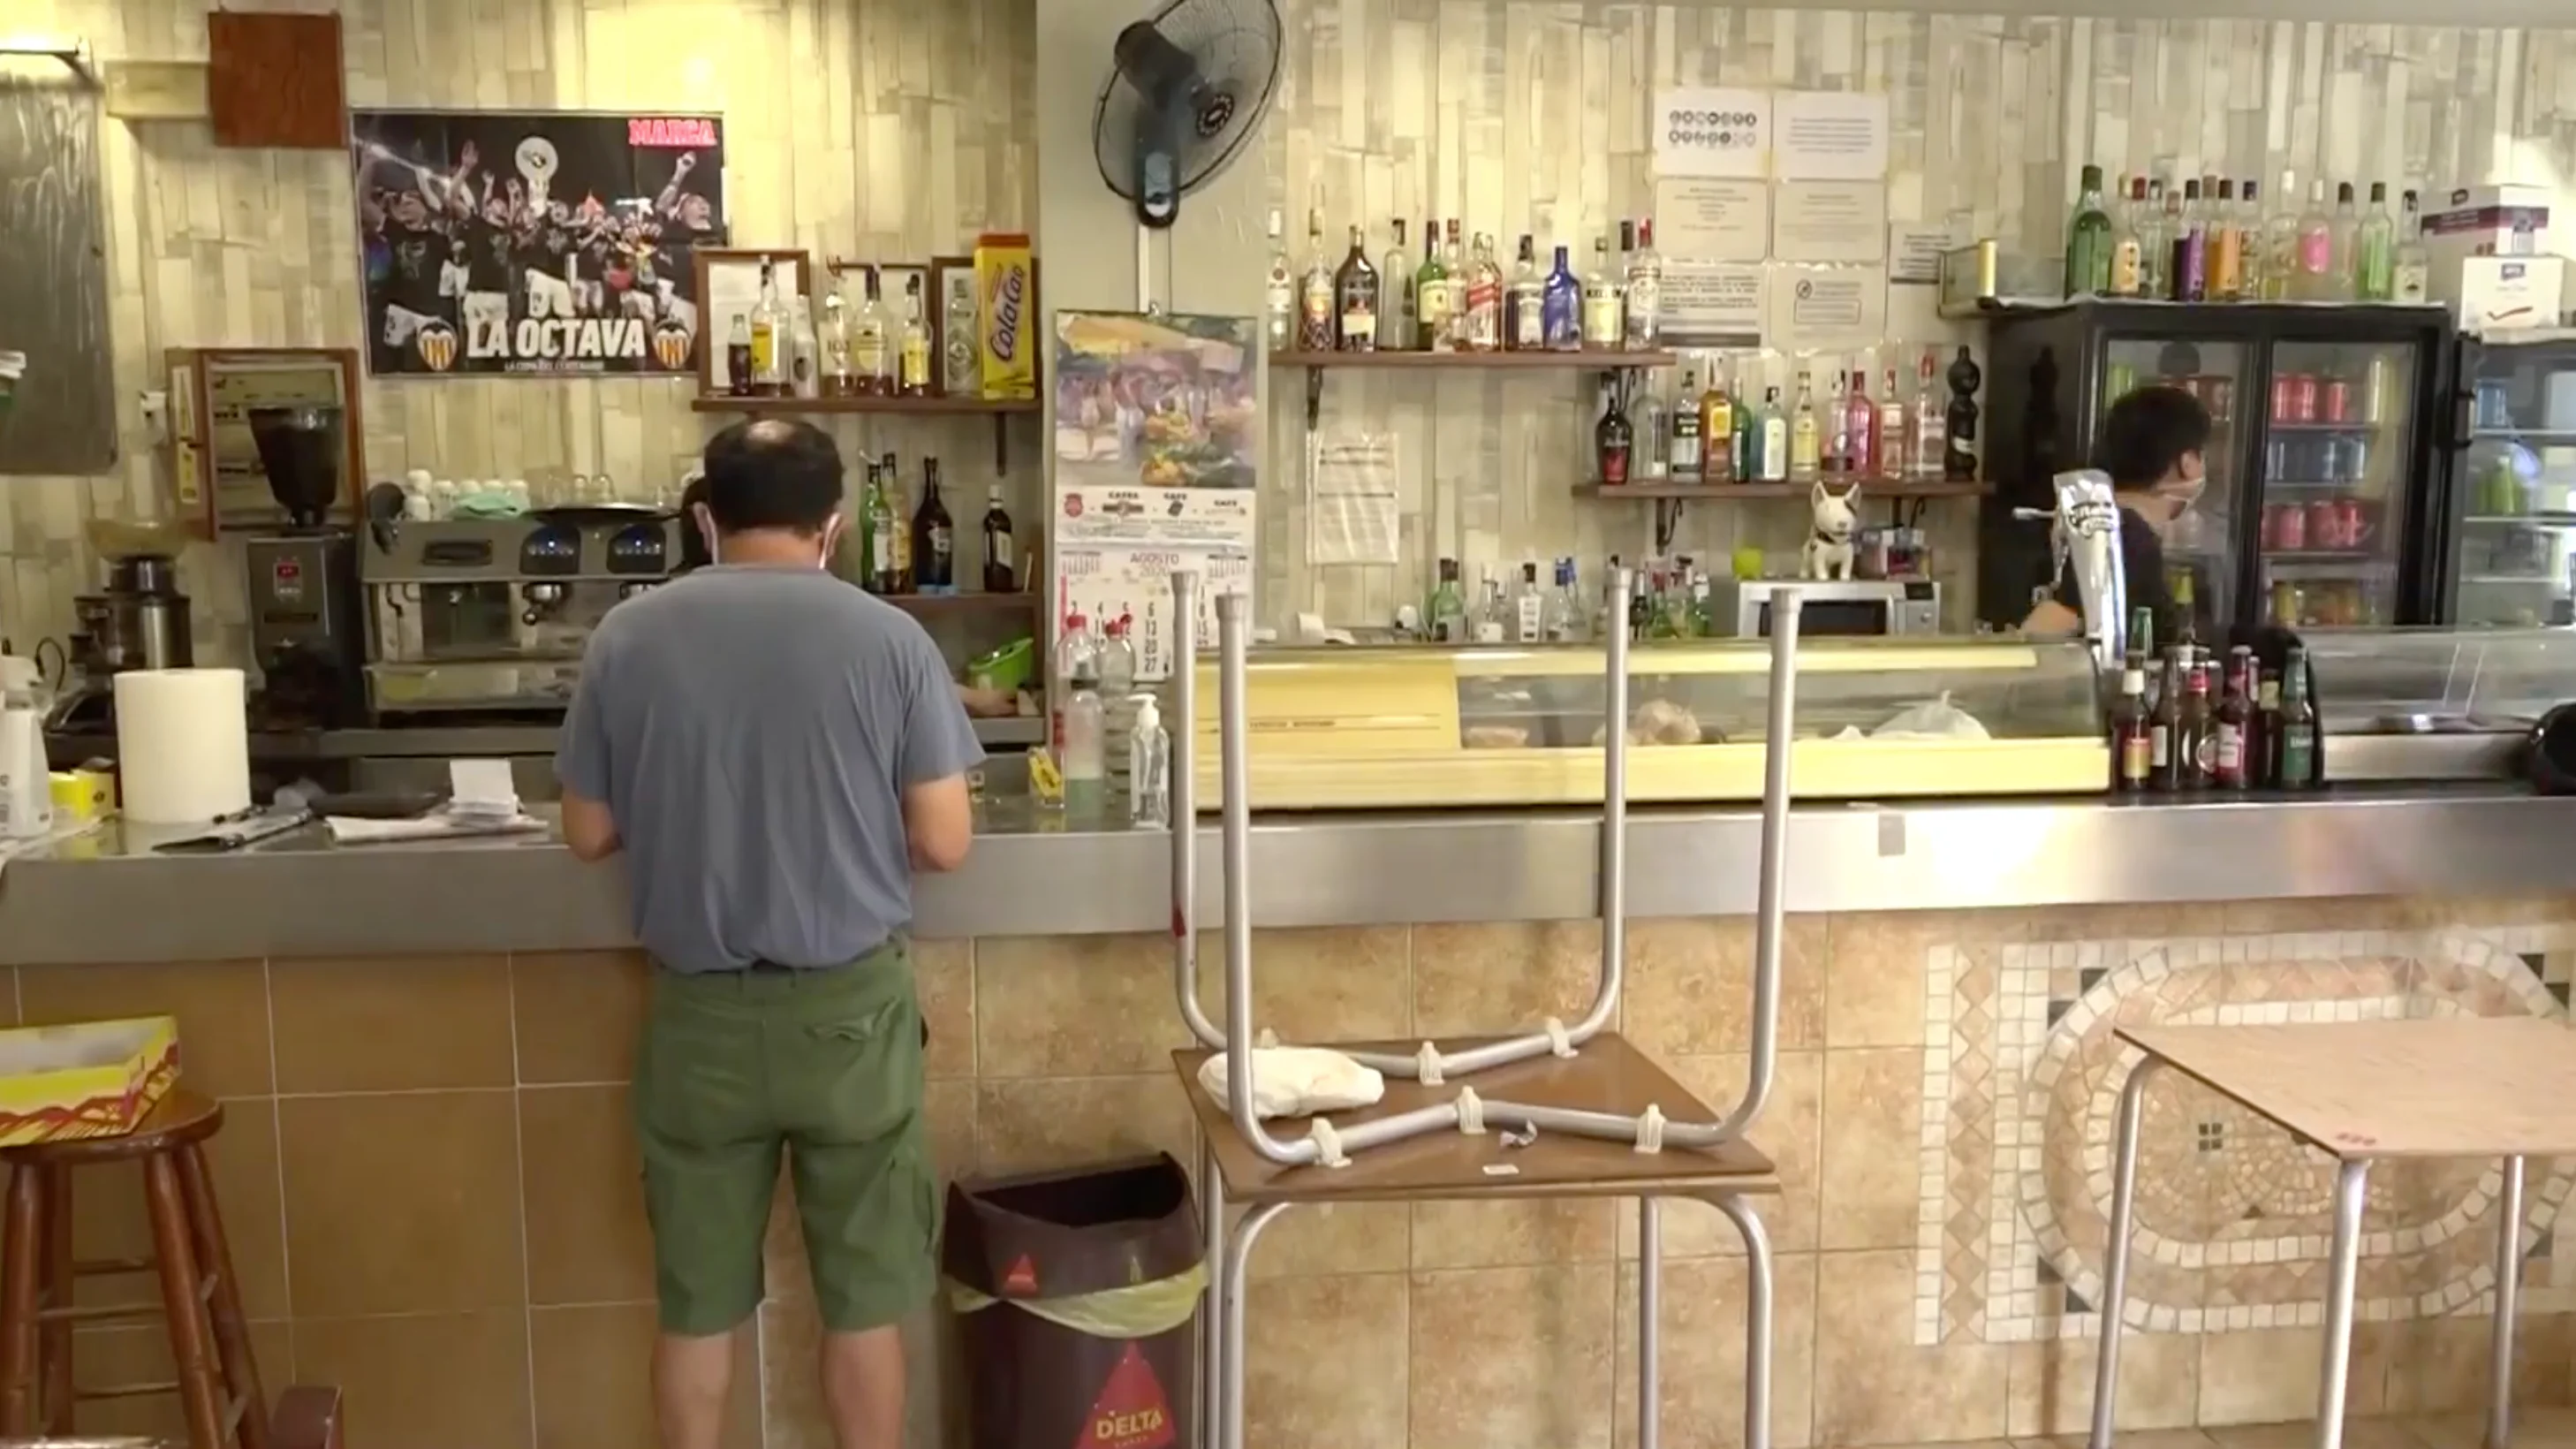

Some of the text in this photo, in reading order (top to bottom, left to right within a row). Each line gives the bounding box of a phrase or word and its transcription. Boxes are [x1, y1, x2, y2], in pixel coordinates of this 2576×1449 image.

[628, 118, 717, 146] MARCA
[466, 318, 647, 358] LA OCTAVA
[1096, 1409, 1163, 1439] DELTA
